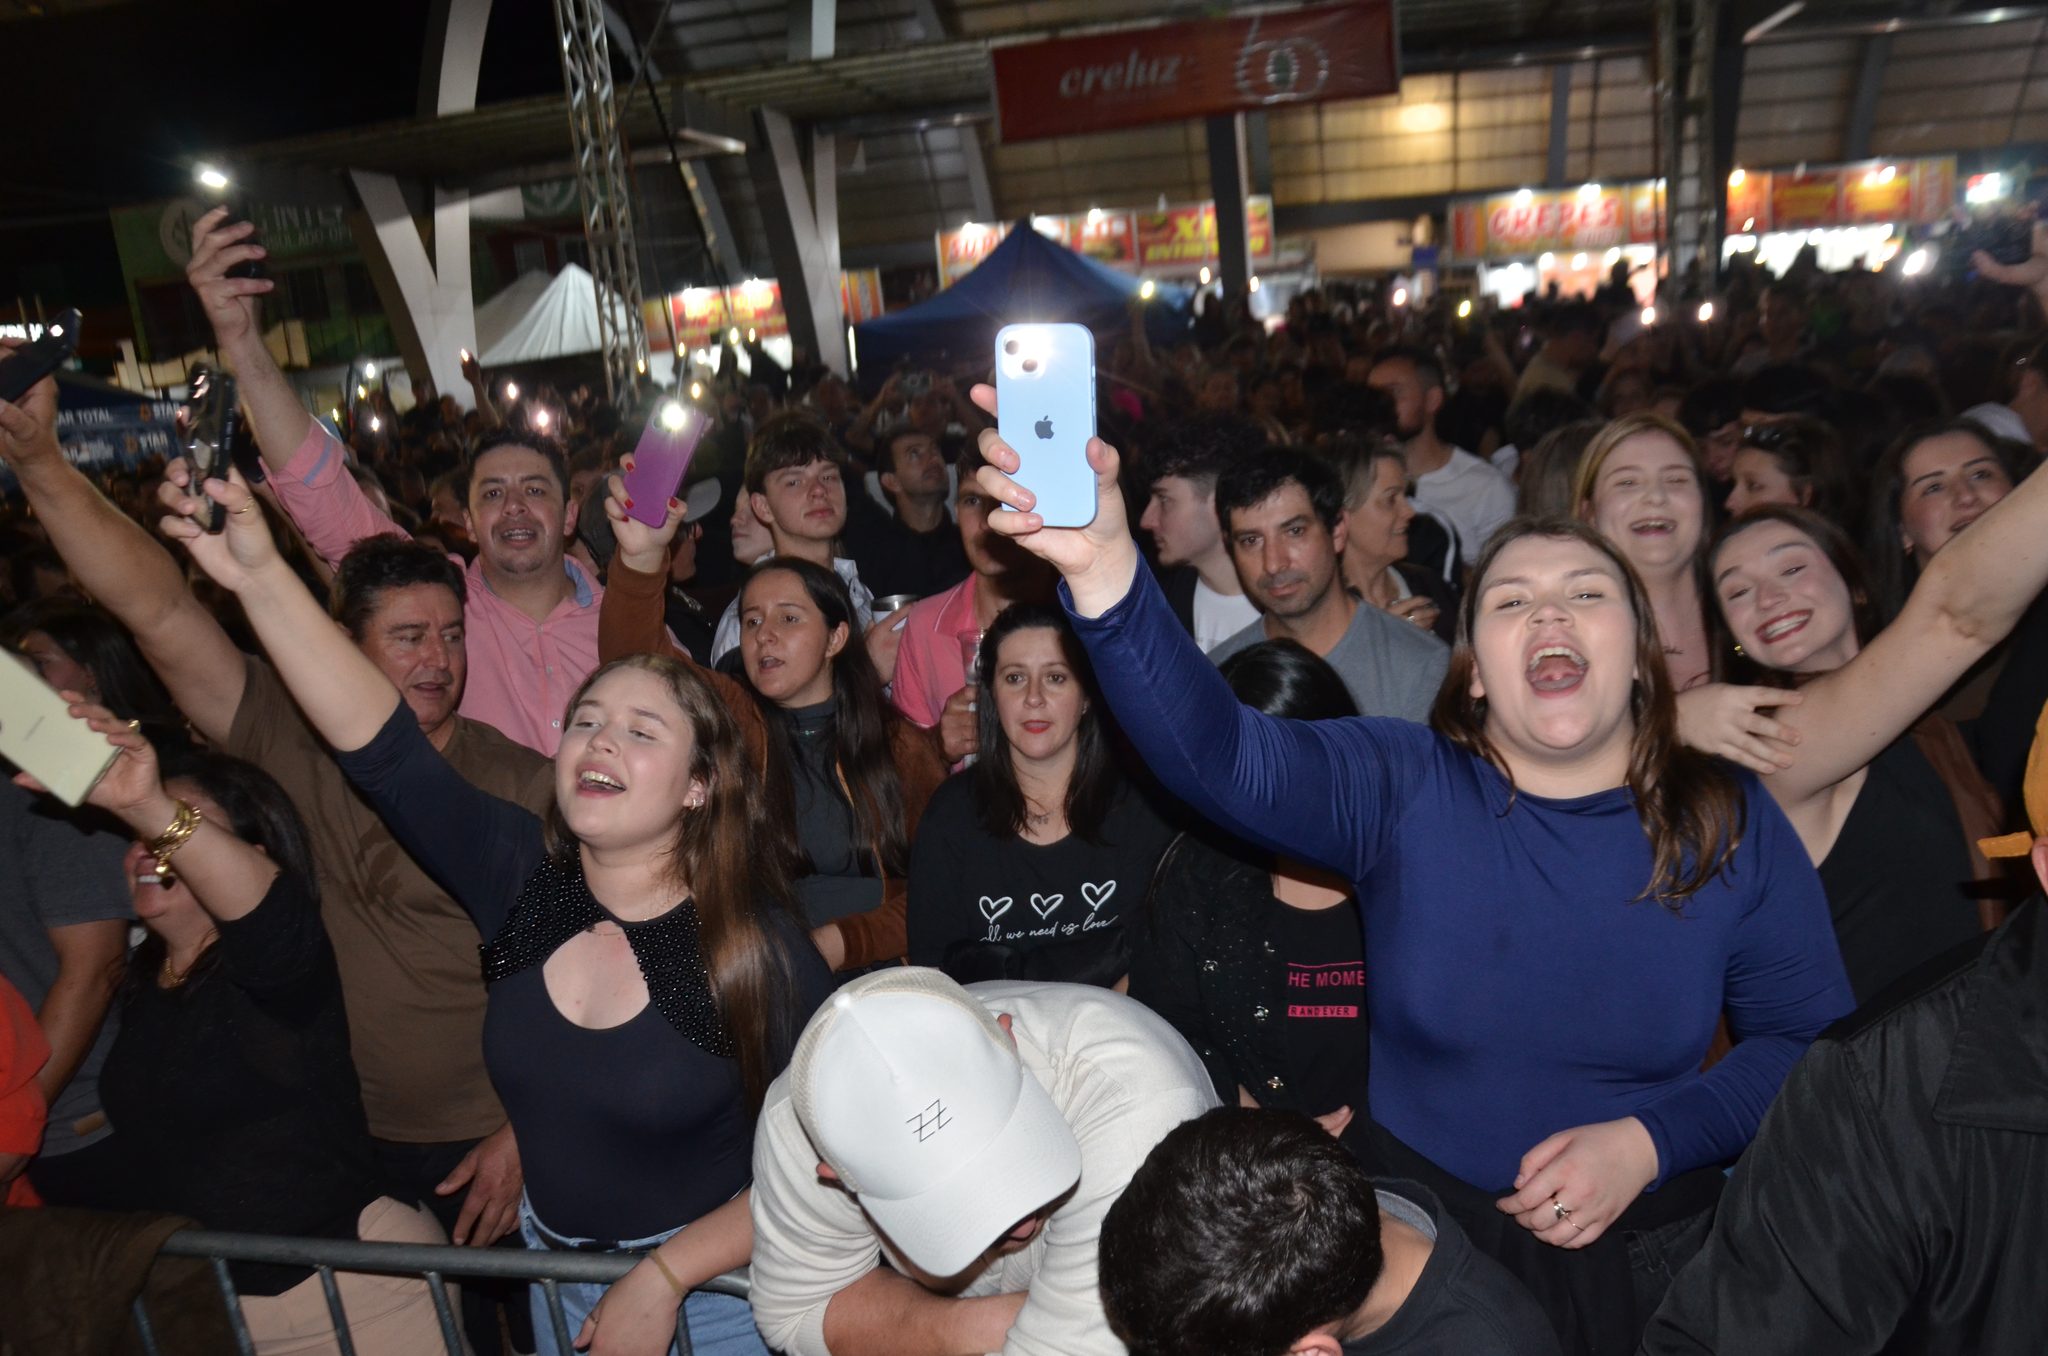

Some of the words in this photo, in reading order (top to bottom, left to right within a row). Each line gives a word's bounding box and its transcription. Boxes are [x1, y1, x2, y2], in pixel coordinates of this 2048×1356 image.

[1059, 48, 1182, 98] creluz
[76, 407, 113, 424] TOTAL
[1006, 928, 1025, 940] we
[1029, 920, 1058, 937] need
[1061, 922, 1080, 936] is
[1082, 912, 1119, 932] love
[1315, 970, 1365, 988] MOME
[1323, 1006, 1350, 1017] EVER
